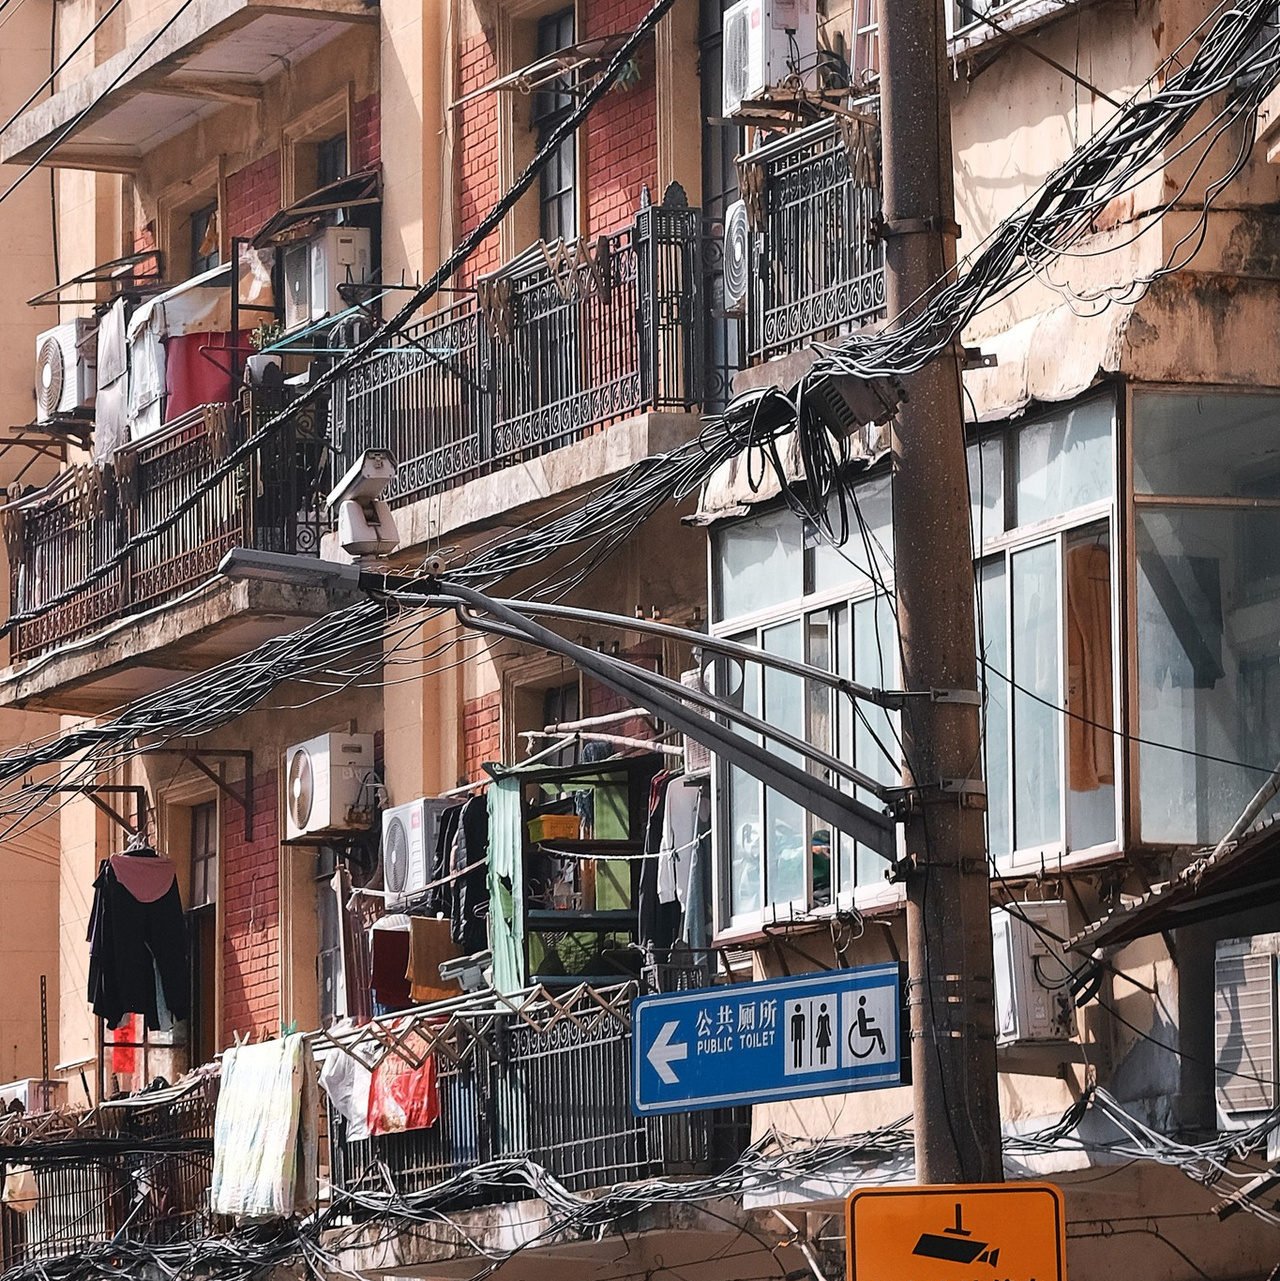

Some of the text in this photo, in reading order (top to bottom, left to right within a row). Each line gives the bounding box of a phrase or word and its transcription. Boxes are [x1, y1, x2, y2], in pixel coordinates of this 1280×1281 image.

[696, 998, 778, 1037] 公共厕所
[697, 1031, 775, 1055] PUBLIC TOILET
